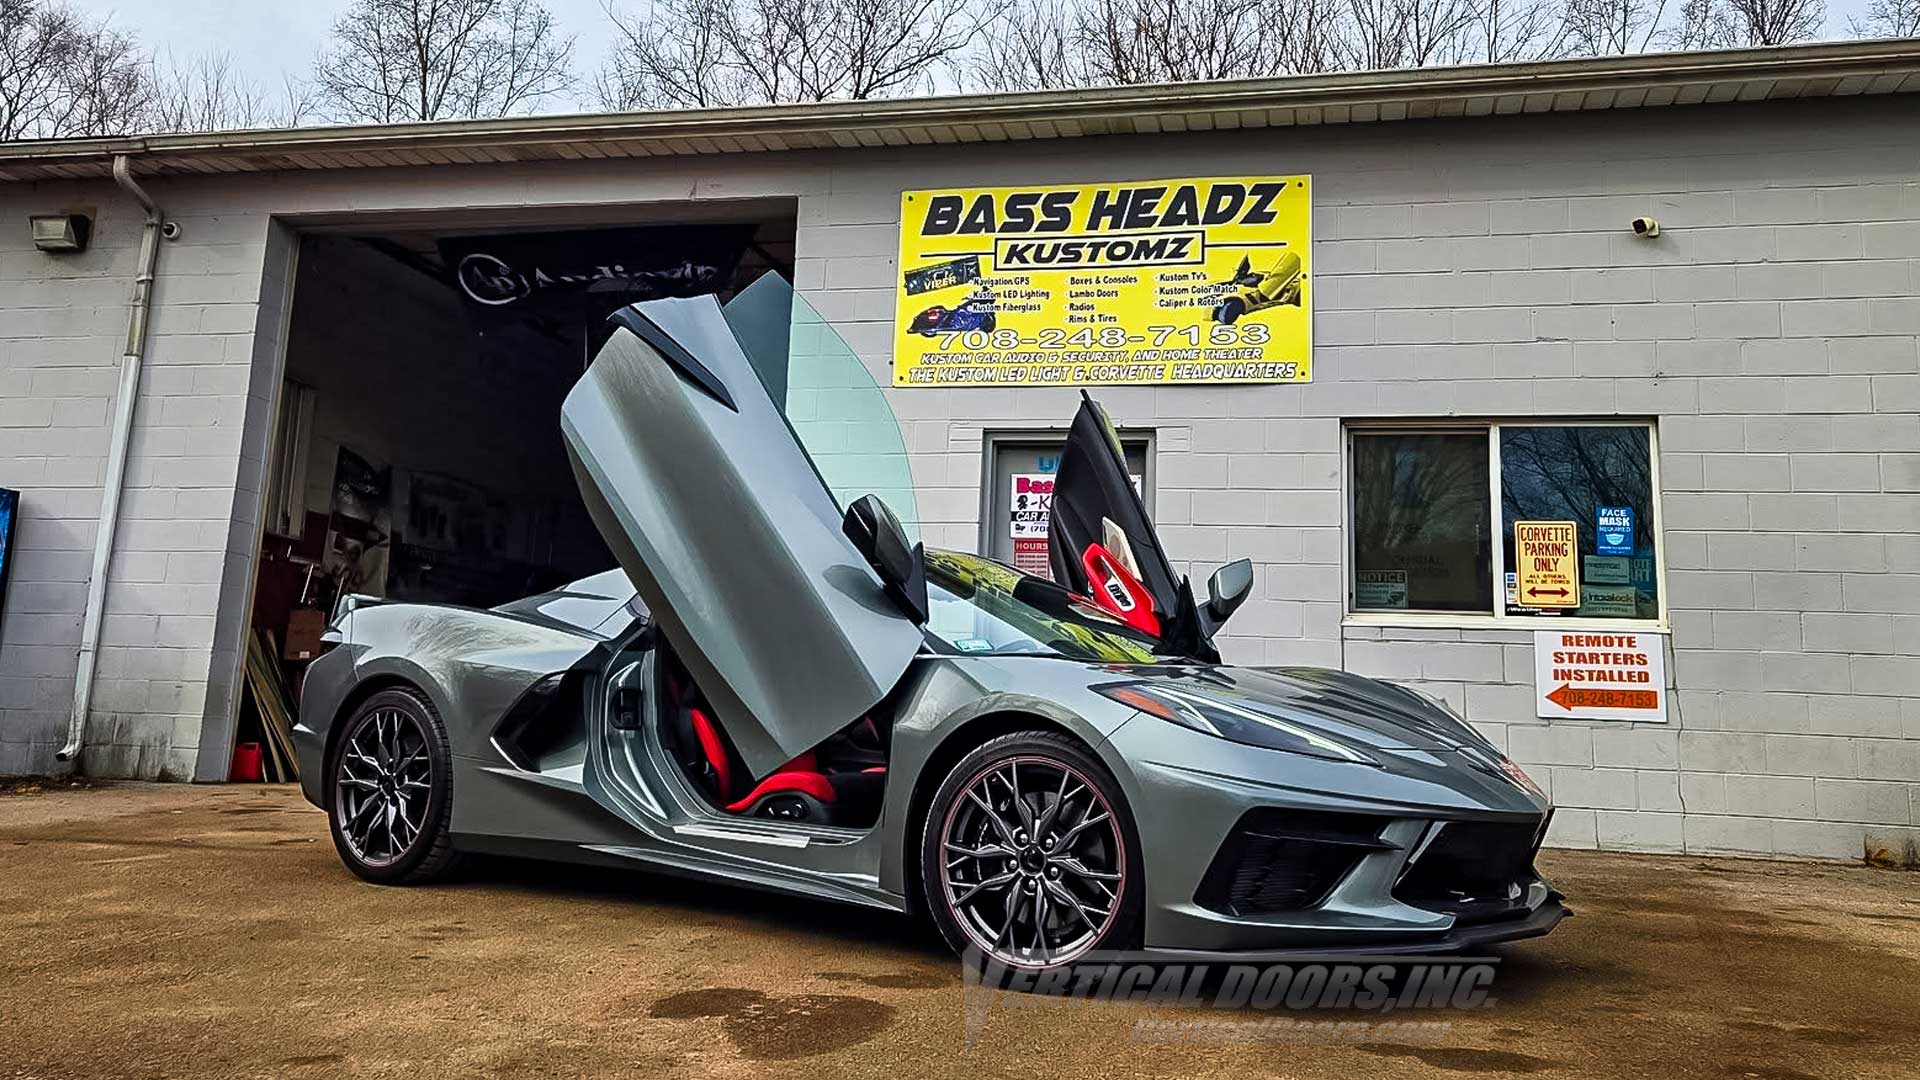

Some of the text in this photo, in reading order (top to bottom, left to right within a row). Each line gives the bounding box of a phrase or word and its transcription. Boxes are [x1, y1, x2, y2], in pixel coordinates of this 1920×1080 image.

[920, 182, 1288, 236] BASS HEADZ
[1002, 236, 1195, 265] KUSTOMZ
[924, 275, 957, 290] VIPER
[973, 276, 1030, 287] Navigation GPS
[1070, 275, 1138, 285] Boxes & Consoles
[1159, 271, 1207, 282] Kustom Tv's
[973, 289, 1050, 300] Kustom LED Lighting
[1069, 289, 1119, 298] Lambo Doors
[1159, 285, 1238, 296] Kustom Color Match
[972, 303, 1041, 313] Kustom Fiberglass
[1069, 302, 1095, 311] Radios
[1159, 297, 1224, 309] Caliper & Rotors
[1068, 313, 1118, 323] Rims & Tires
[936, 323, 1271, 350] 708-248-7153
[921, 347, 1263, 365] KUSTOM CAR AUDIO & SECURITY, AND HOME THEATER
[909, 362, 1297, 384] THE KUSTOM LED LIGHT & CORVETTE HEADQUARTERS
[1016, 477, 1054, 494] Bas
[1016, 511, 1038, 522] CAR
[1601, 508, 1627, 517] FACE
[1599, 516, 1630, 527] MASK
[1030, 525, 1048, 533] (70
[1520, 527, 1572, 542] CORVETTE
[1016, 543, 1048, 551] HOURS
[1524, 542, 1569, 557] PARKING
[1533, 557, 1560, 572] ONLY
[1561, 634, 1637, 648] REMOTE
[1552, 651, 1649, 666] STARTERS
[1552, 668, 1650, 683] INSTALLED
[1561, 690, 1652, 706] 708-248-7153
